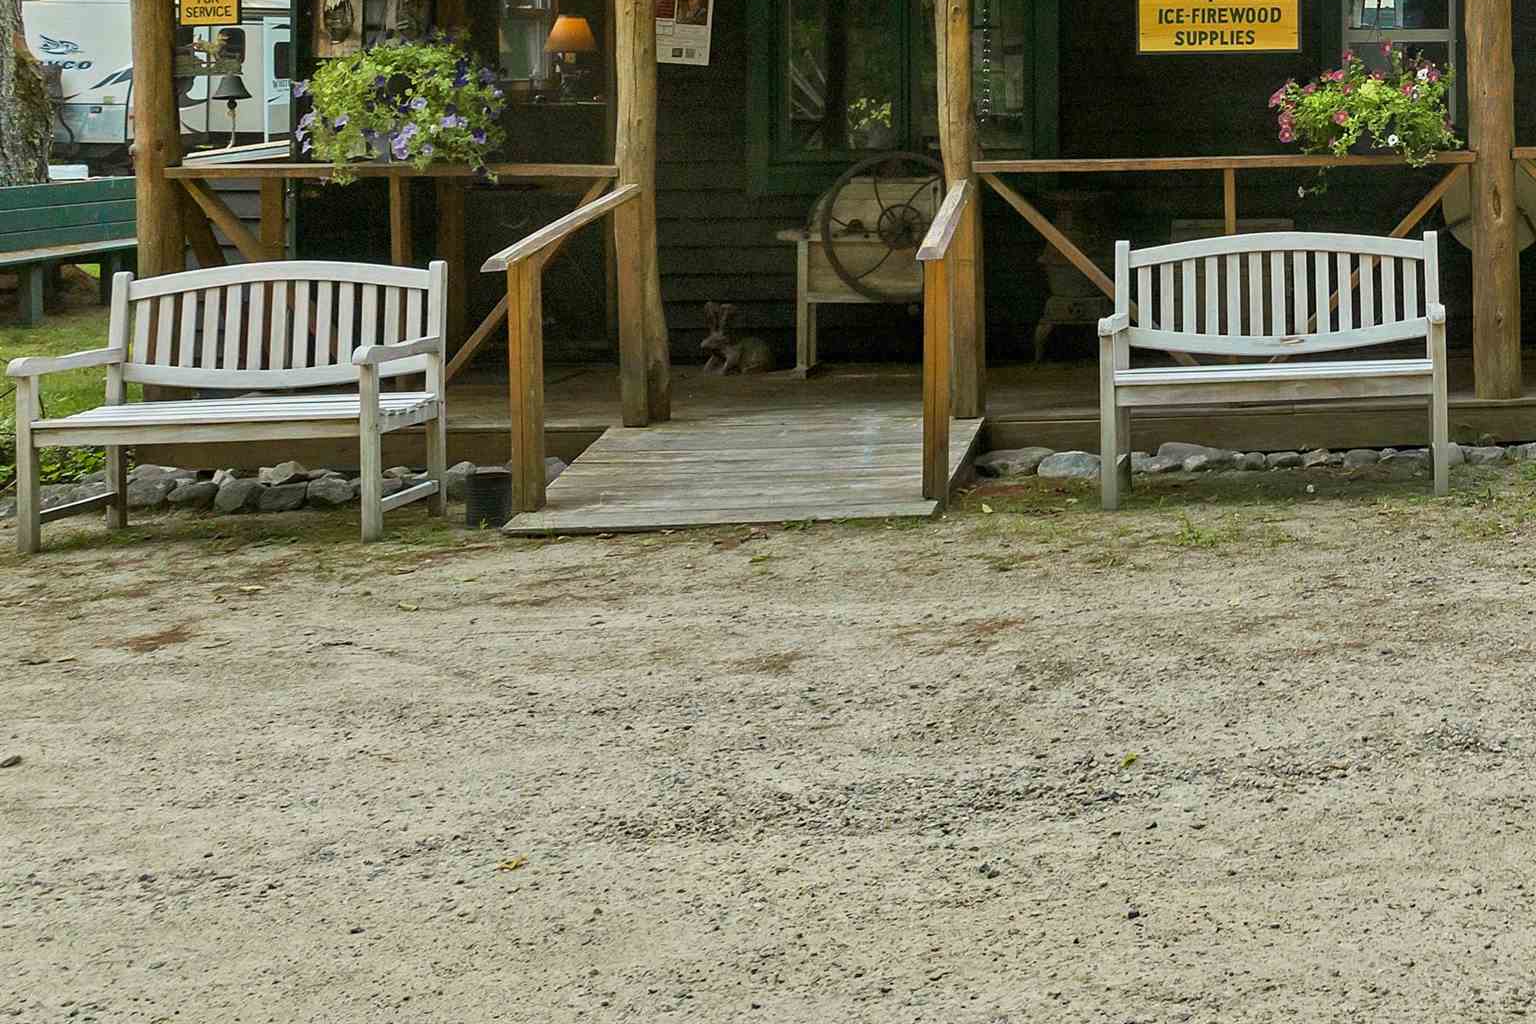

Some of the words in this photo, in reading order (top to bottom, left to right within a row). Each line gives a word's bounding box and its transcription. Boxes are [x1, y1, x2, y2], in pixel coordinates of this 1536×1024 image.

[185, 5, 233, 18] SERVICE
[1158, 7, 1282, 25] ICE-FIREWOOD
[1174, 29, 1256, 46] SUPPLIES
